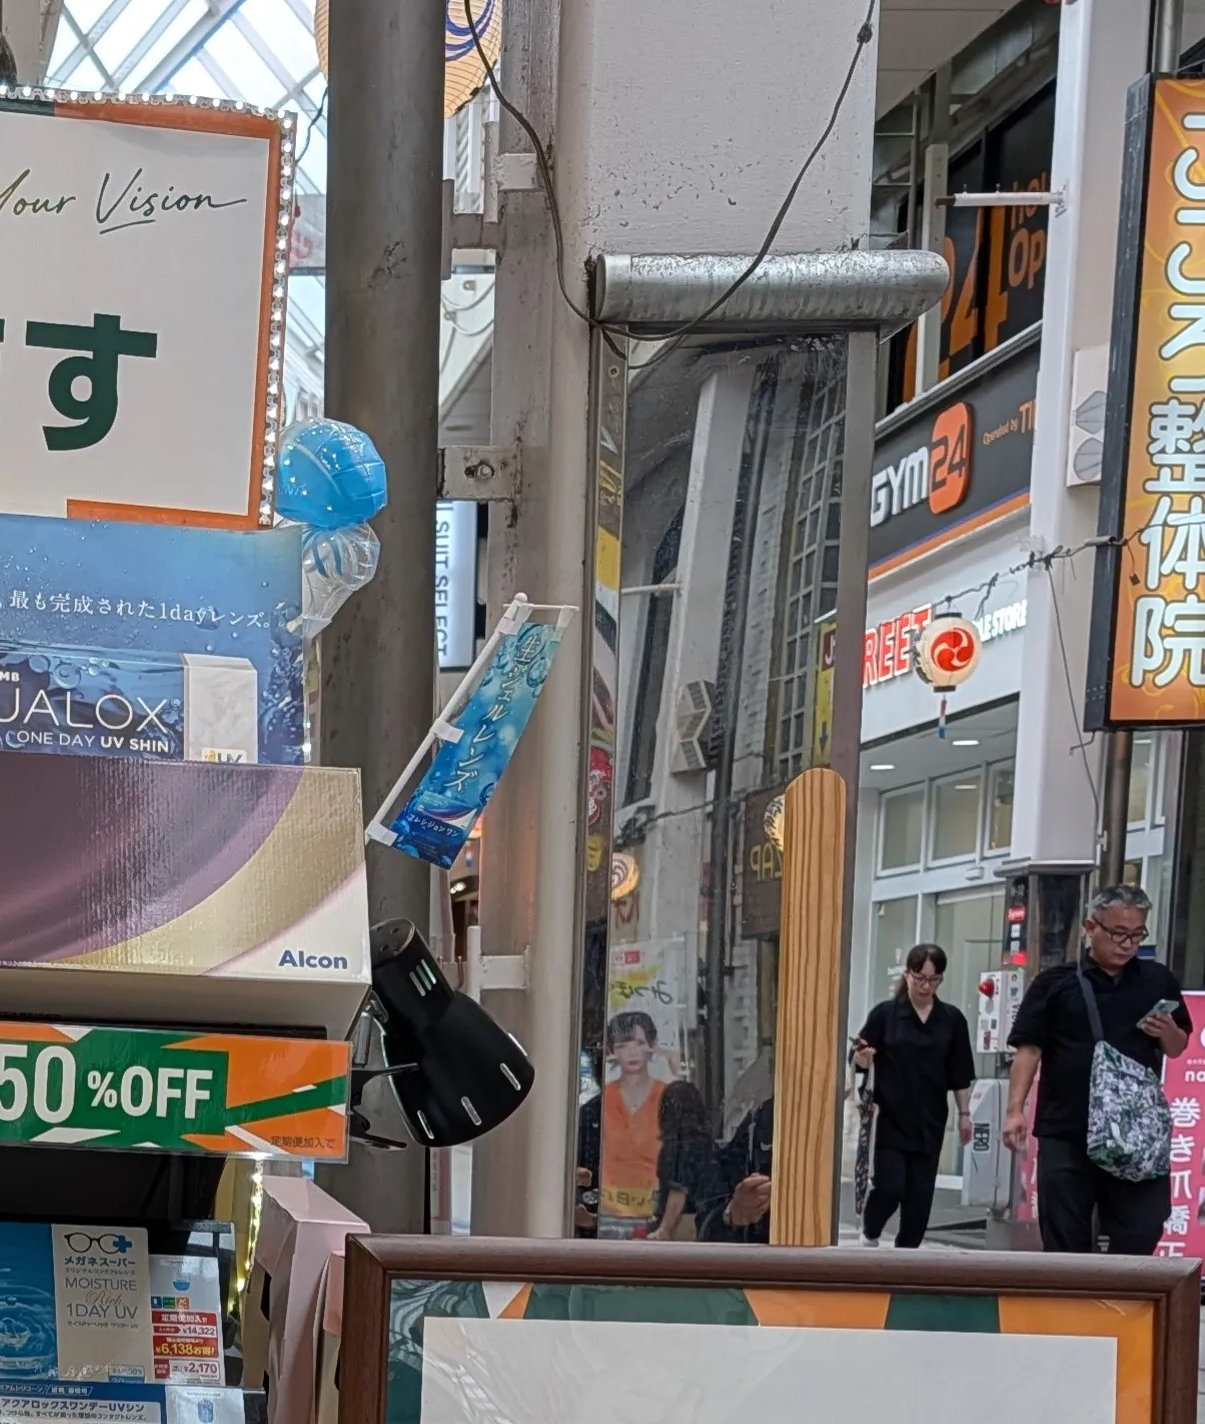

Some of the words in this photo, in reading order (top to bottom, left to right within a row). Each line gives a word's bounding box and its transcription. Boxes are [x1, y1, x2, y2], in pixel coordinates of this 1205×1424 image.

[97, 168, 248, 235] Vision
[870, 446, 929, 528] GYM
[932, 424, 967, 492] 24
[444, 635, 540, 792] 生ジェルレンズ
[17, 730, 54, 748] ONE
[59, 732, 96, 748] DAY
[100, 735, 126, 751] UV
[129, 737, 170, 753] SHIN
[278, 950, 348, 971] Alcon
[270, 1134, 335, 1151] 定期便加入で
[64, 1256, 136, 1266] メガネスーパー
[65, 1278, 137, 1291] MOISTURE
[66, 1303, 109, 1318] 1DAY
[115, 1306, 137, 1320] UV
